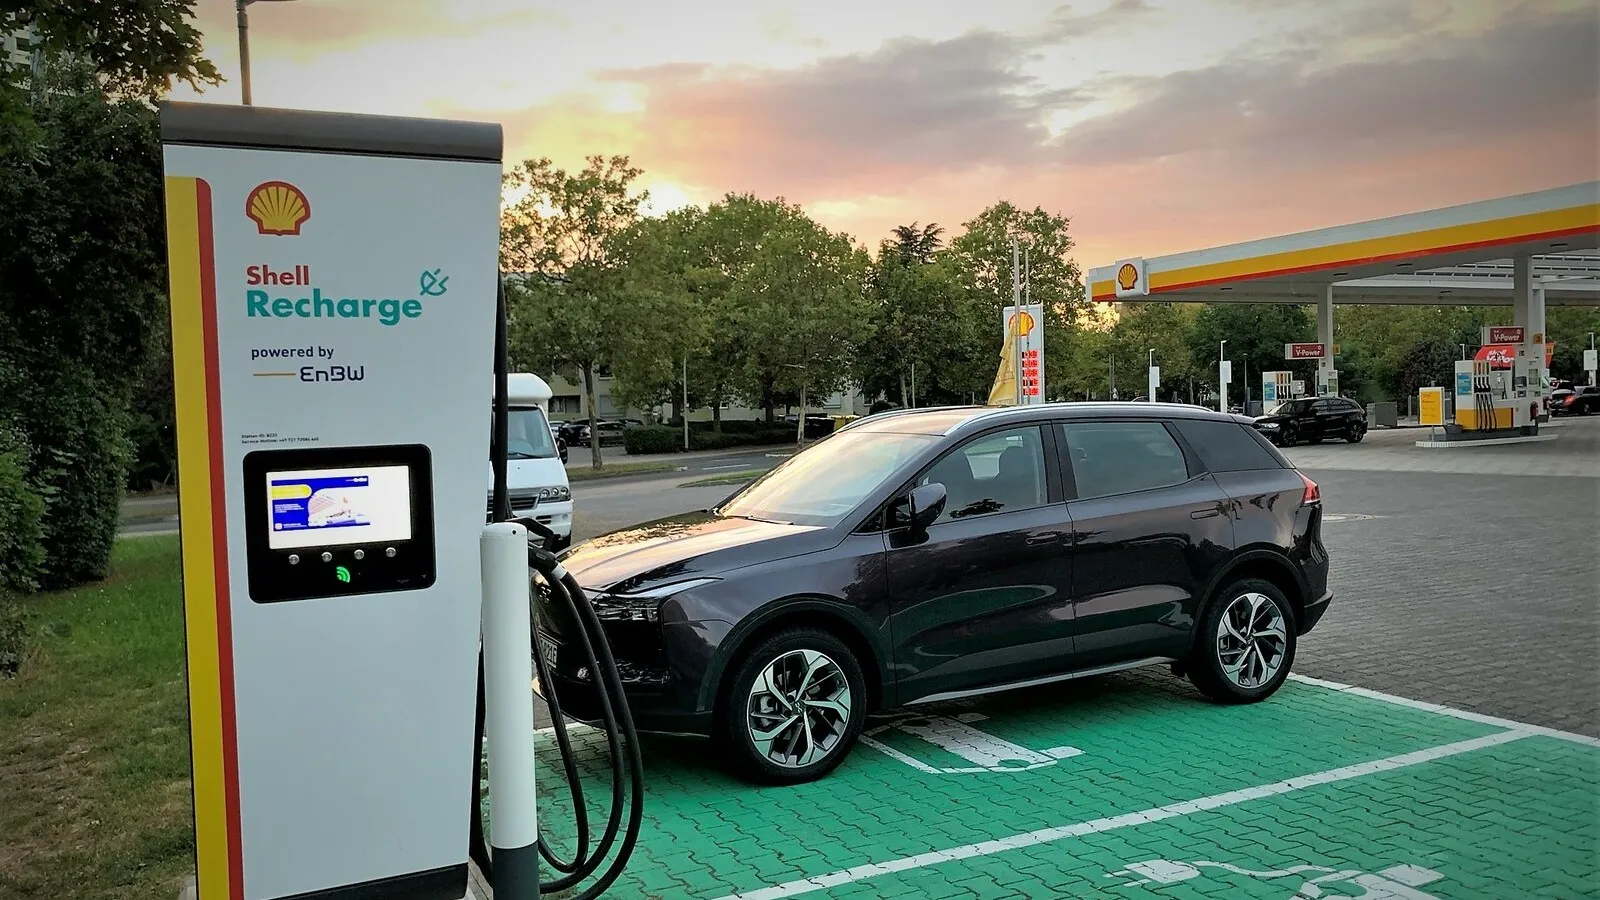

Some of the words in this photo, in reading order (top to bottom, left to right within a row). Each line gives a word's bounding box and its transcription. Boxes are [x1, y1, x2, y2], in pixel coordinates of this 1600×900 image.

[246, 264, 310, 286] Shell
[246, 288, 422, 326] Recharge
[251, 346, 314, 360] powered
[318, 346, 335, 360] by
[300, 366, 364, 382] EnBW
